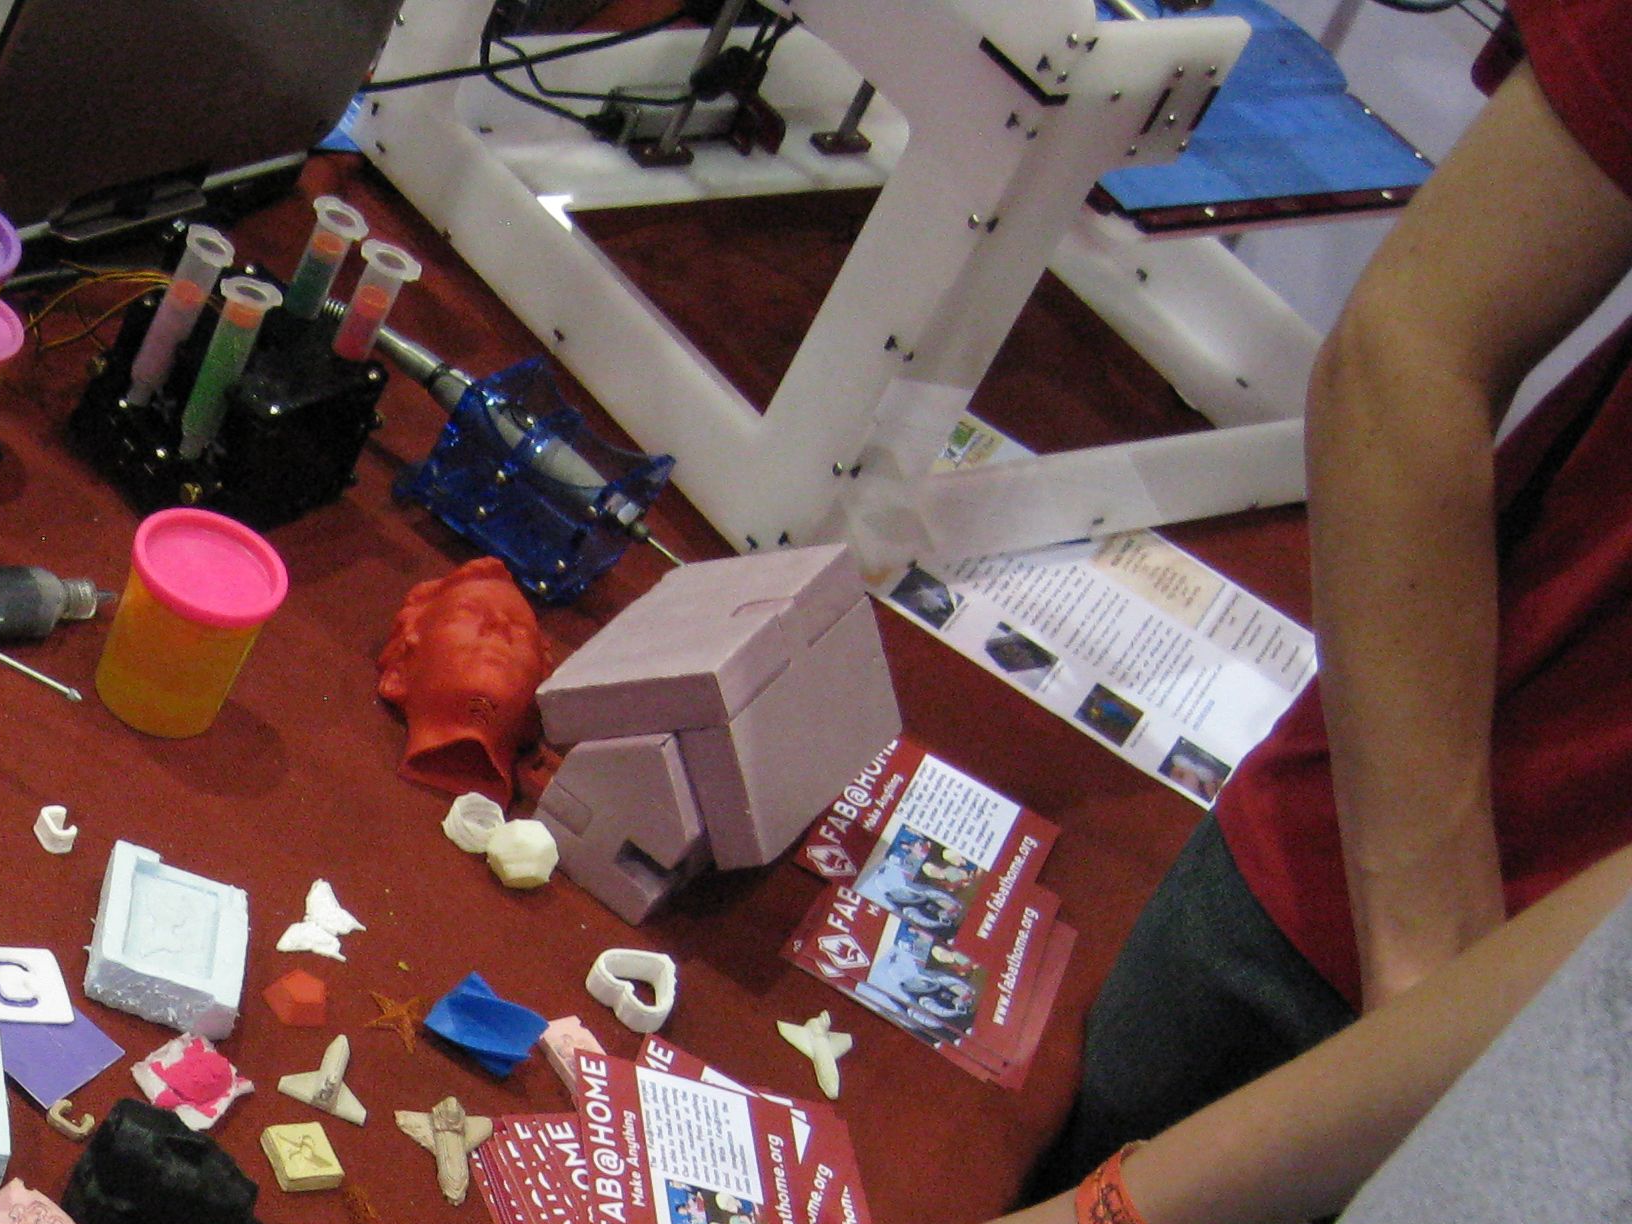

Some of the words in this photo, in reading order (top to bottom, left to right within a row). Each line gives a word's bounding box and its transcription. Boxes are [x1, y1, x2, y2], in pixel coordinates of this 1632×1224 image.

[976, 835, 1038, 940] www.fabathome.org
[992, 906, 1040, 1026] www.fabathome.org
[623, 1109, 641, 1169] Anything
[629, 1171, 646, 1208] Make
